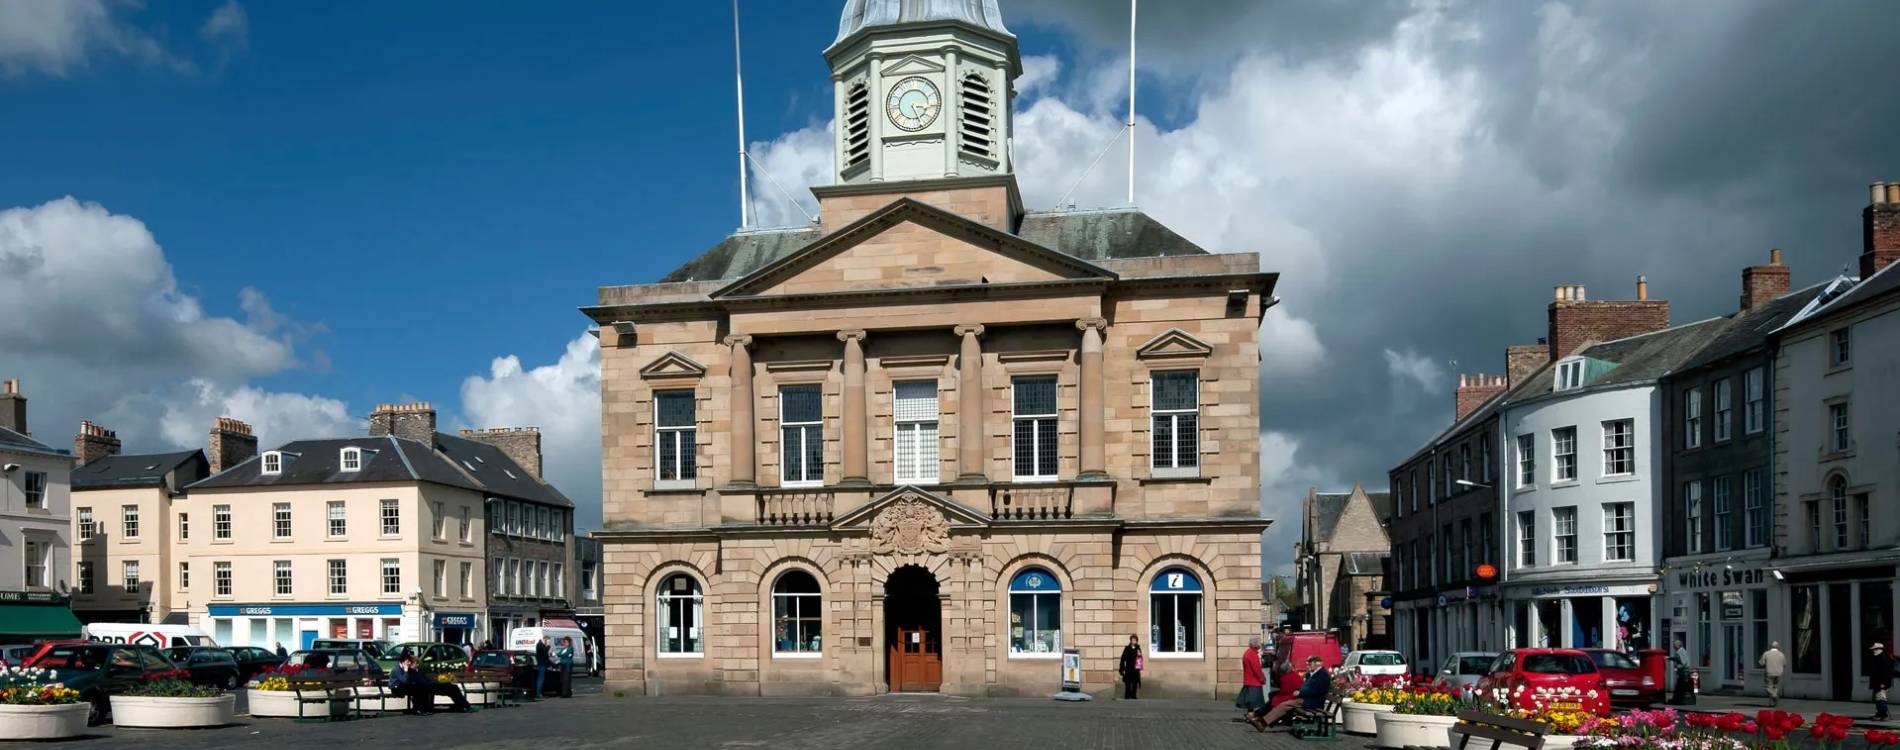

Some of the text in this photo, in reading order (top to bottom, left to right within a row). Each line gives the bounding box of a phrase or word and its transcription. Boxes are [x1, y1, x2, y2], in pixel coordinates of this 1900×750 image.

[1679, 568, 1763, 588] White Swan
[246, 607, 272, 615] GREGGS
[352, 606, 379, 614] GREGGS
